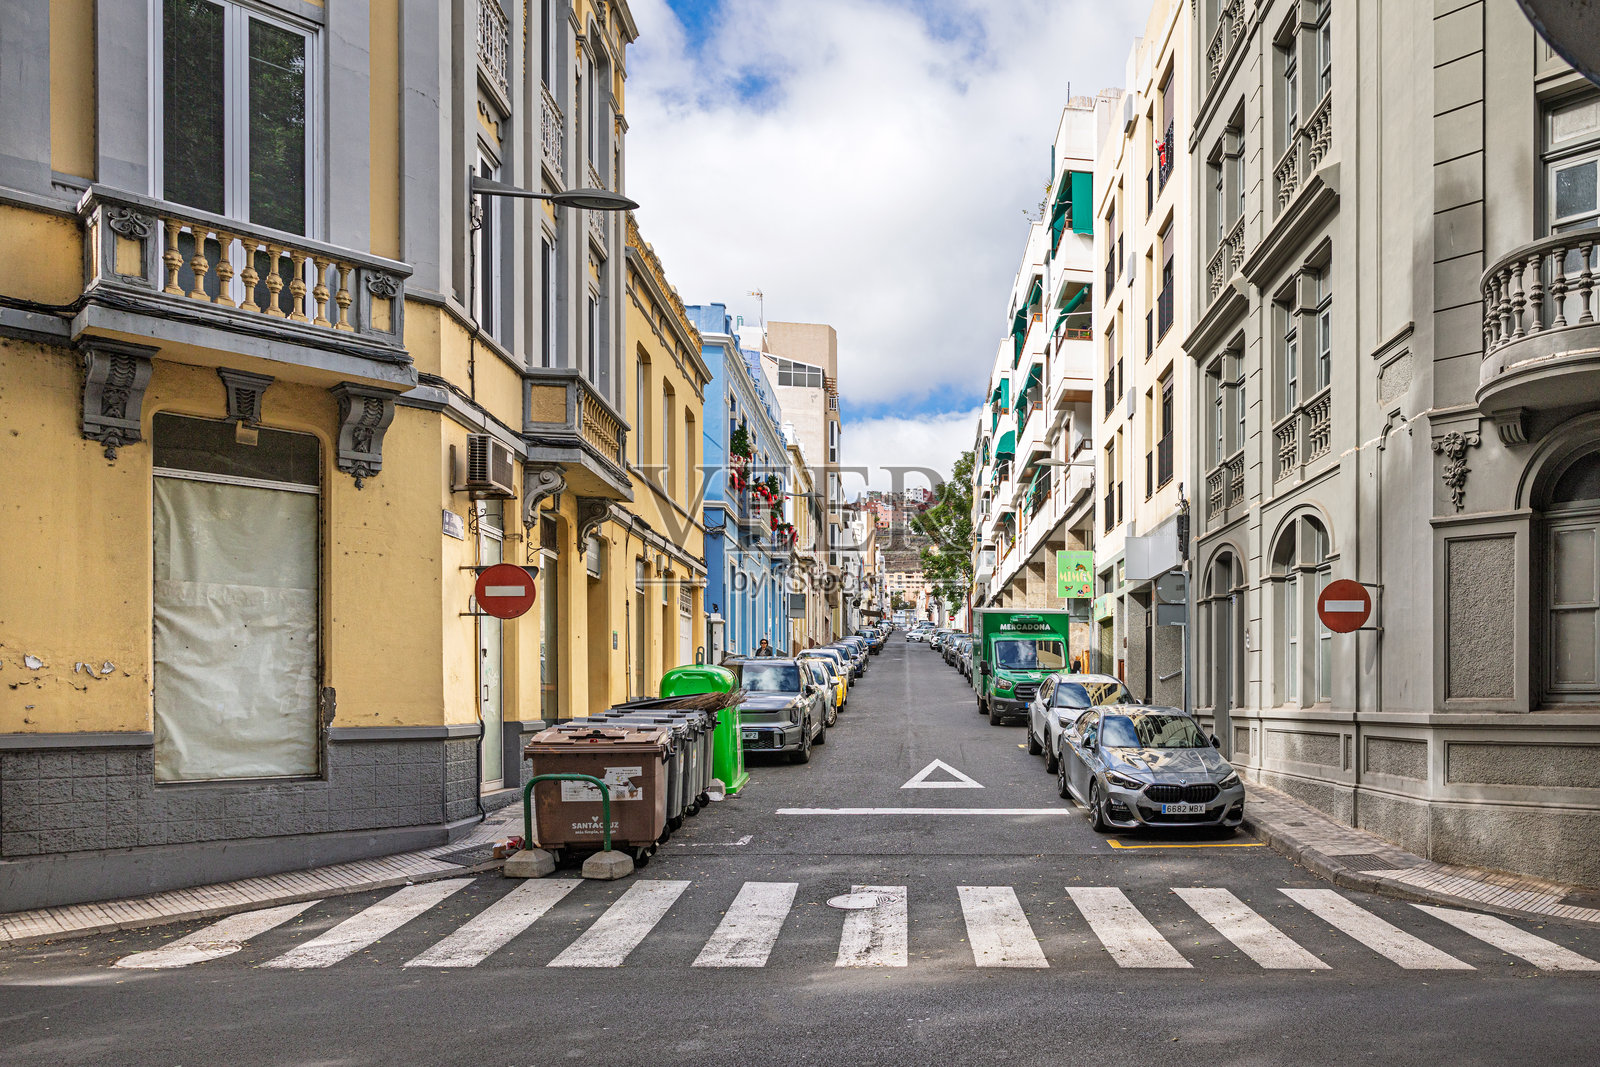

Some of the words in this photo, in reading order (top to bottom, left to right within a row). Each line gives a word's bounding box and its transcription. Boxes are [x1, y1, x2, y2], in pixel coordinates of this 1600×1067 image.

[1000, 623, 1051, 631] MERCADONA
[1166, 805, 1187, 813] 6682
[571, 821, 619, 830] SANTACUZ
